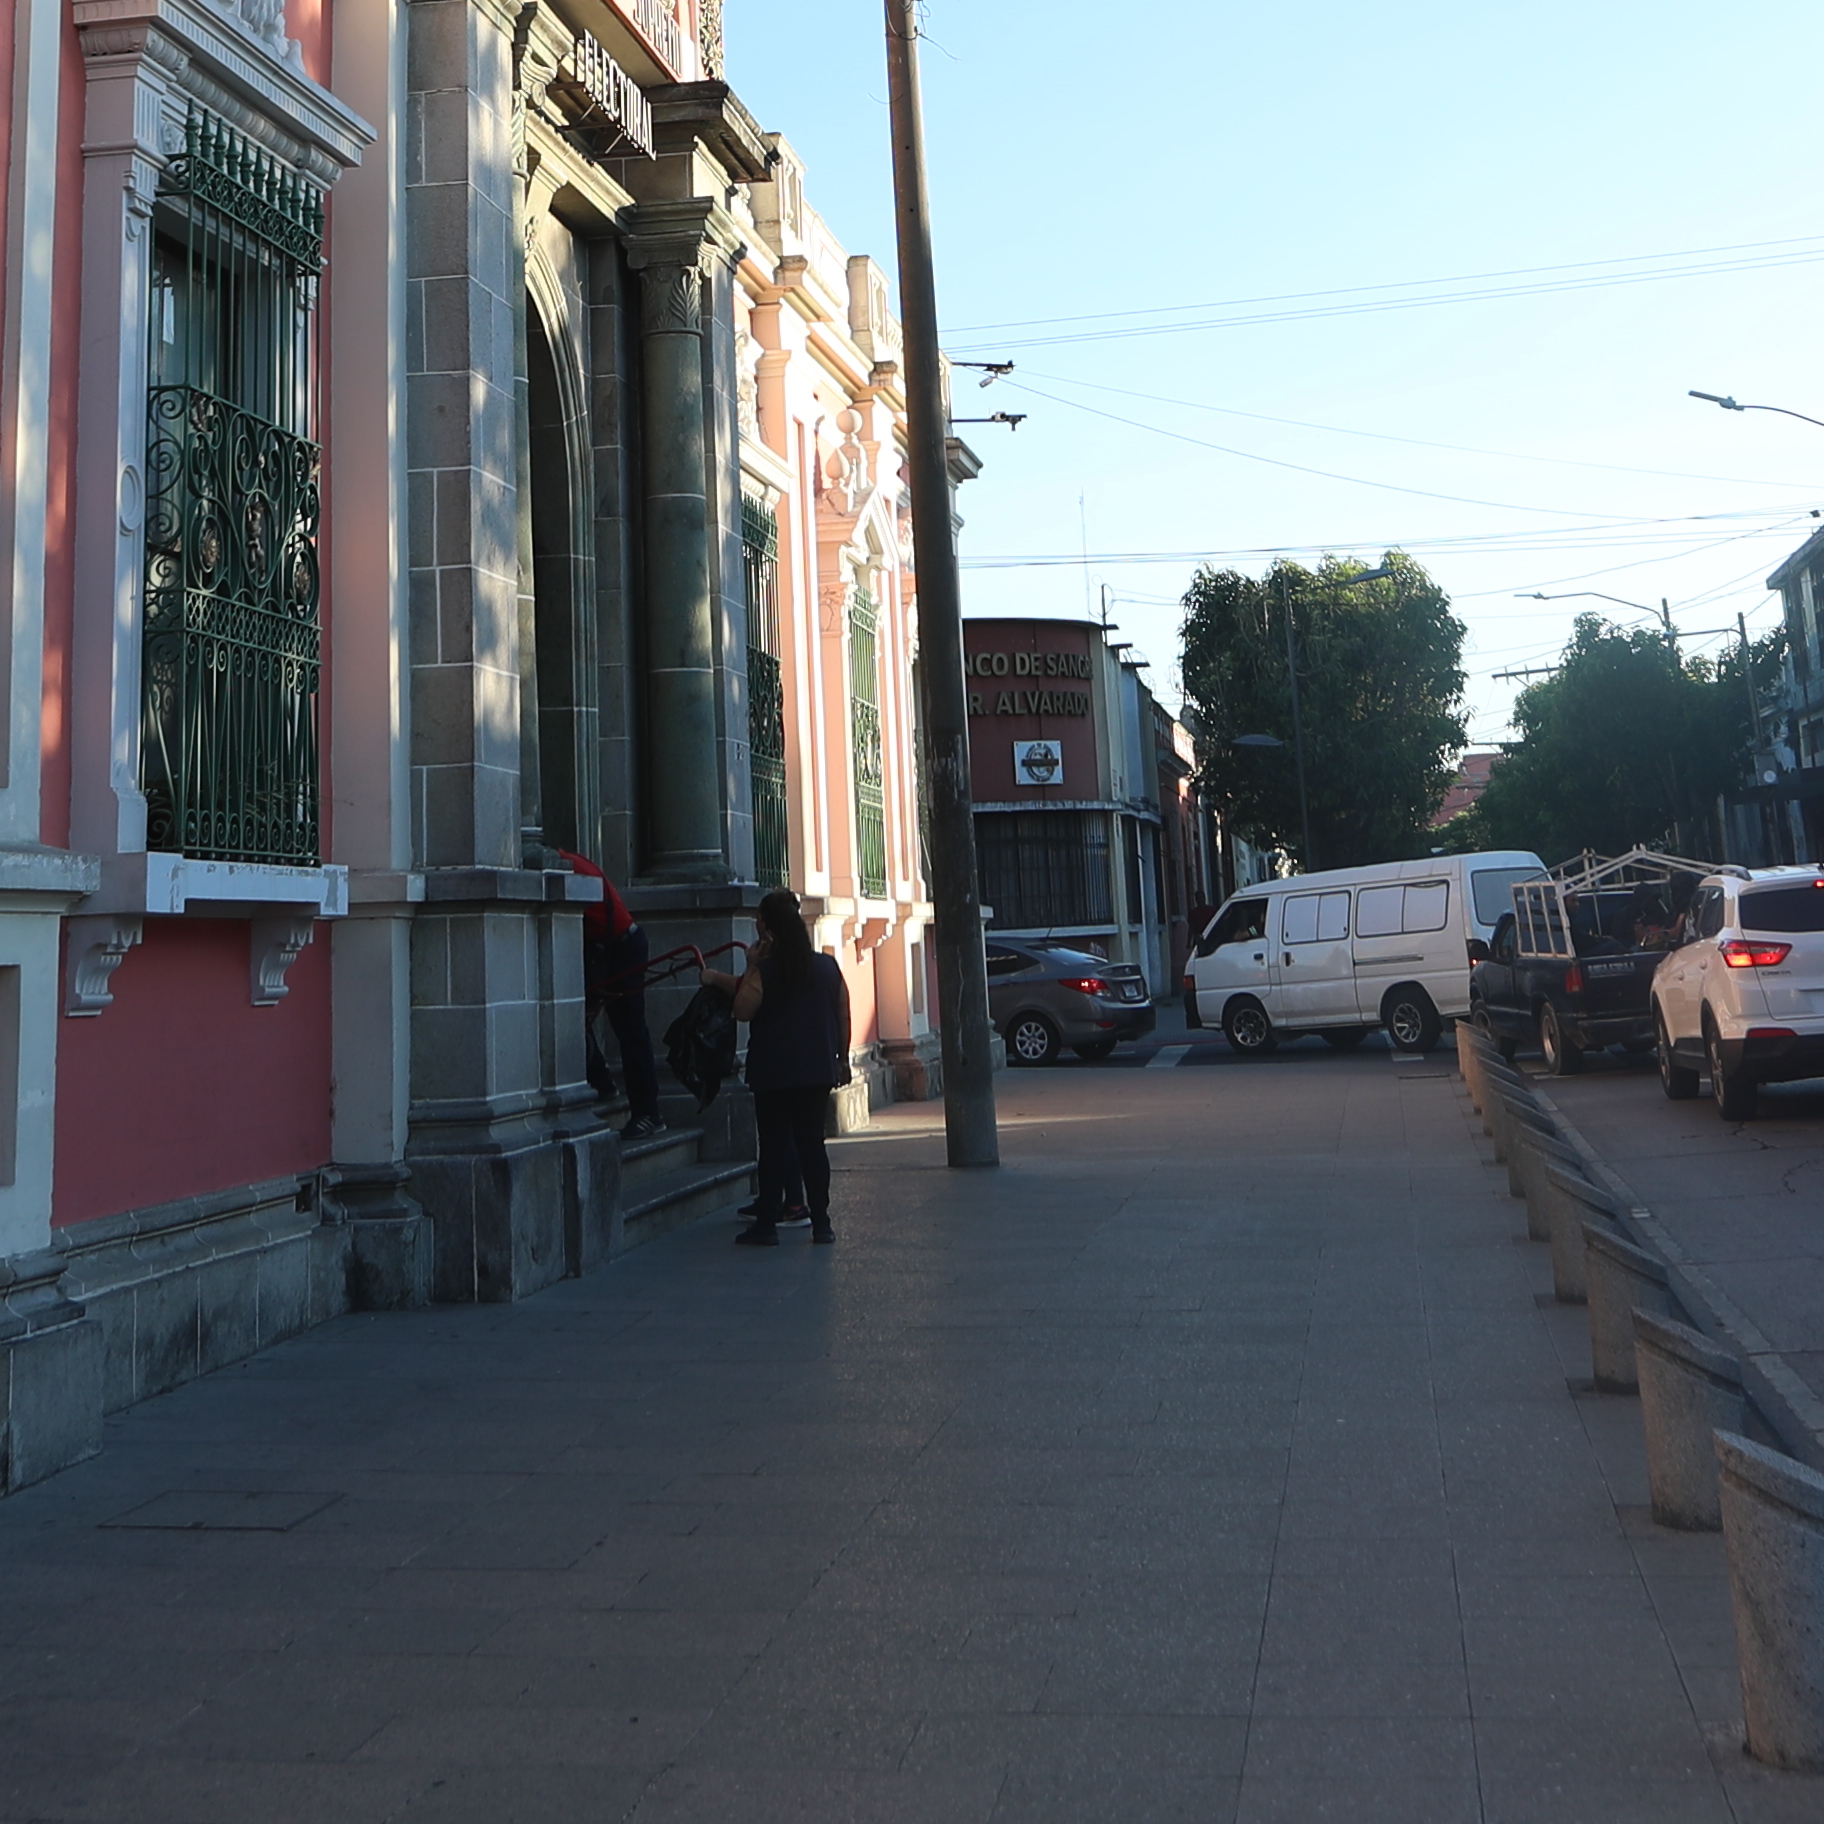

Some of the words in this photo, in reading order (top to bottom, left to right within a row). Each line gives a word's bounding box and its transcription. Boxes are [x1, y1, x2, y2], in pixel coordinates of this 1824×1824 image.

[584, 28, 656, 161] ELECTORAL
[965, 652, 1009, 677] NCO
[1015, 652, 1042, 676] DE
[969, 693, 990, 715] R.
[996, 691, 1090, 718] ALVARADO
